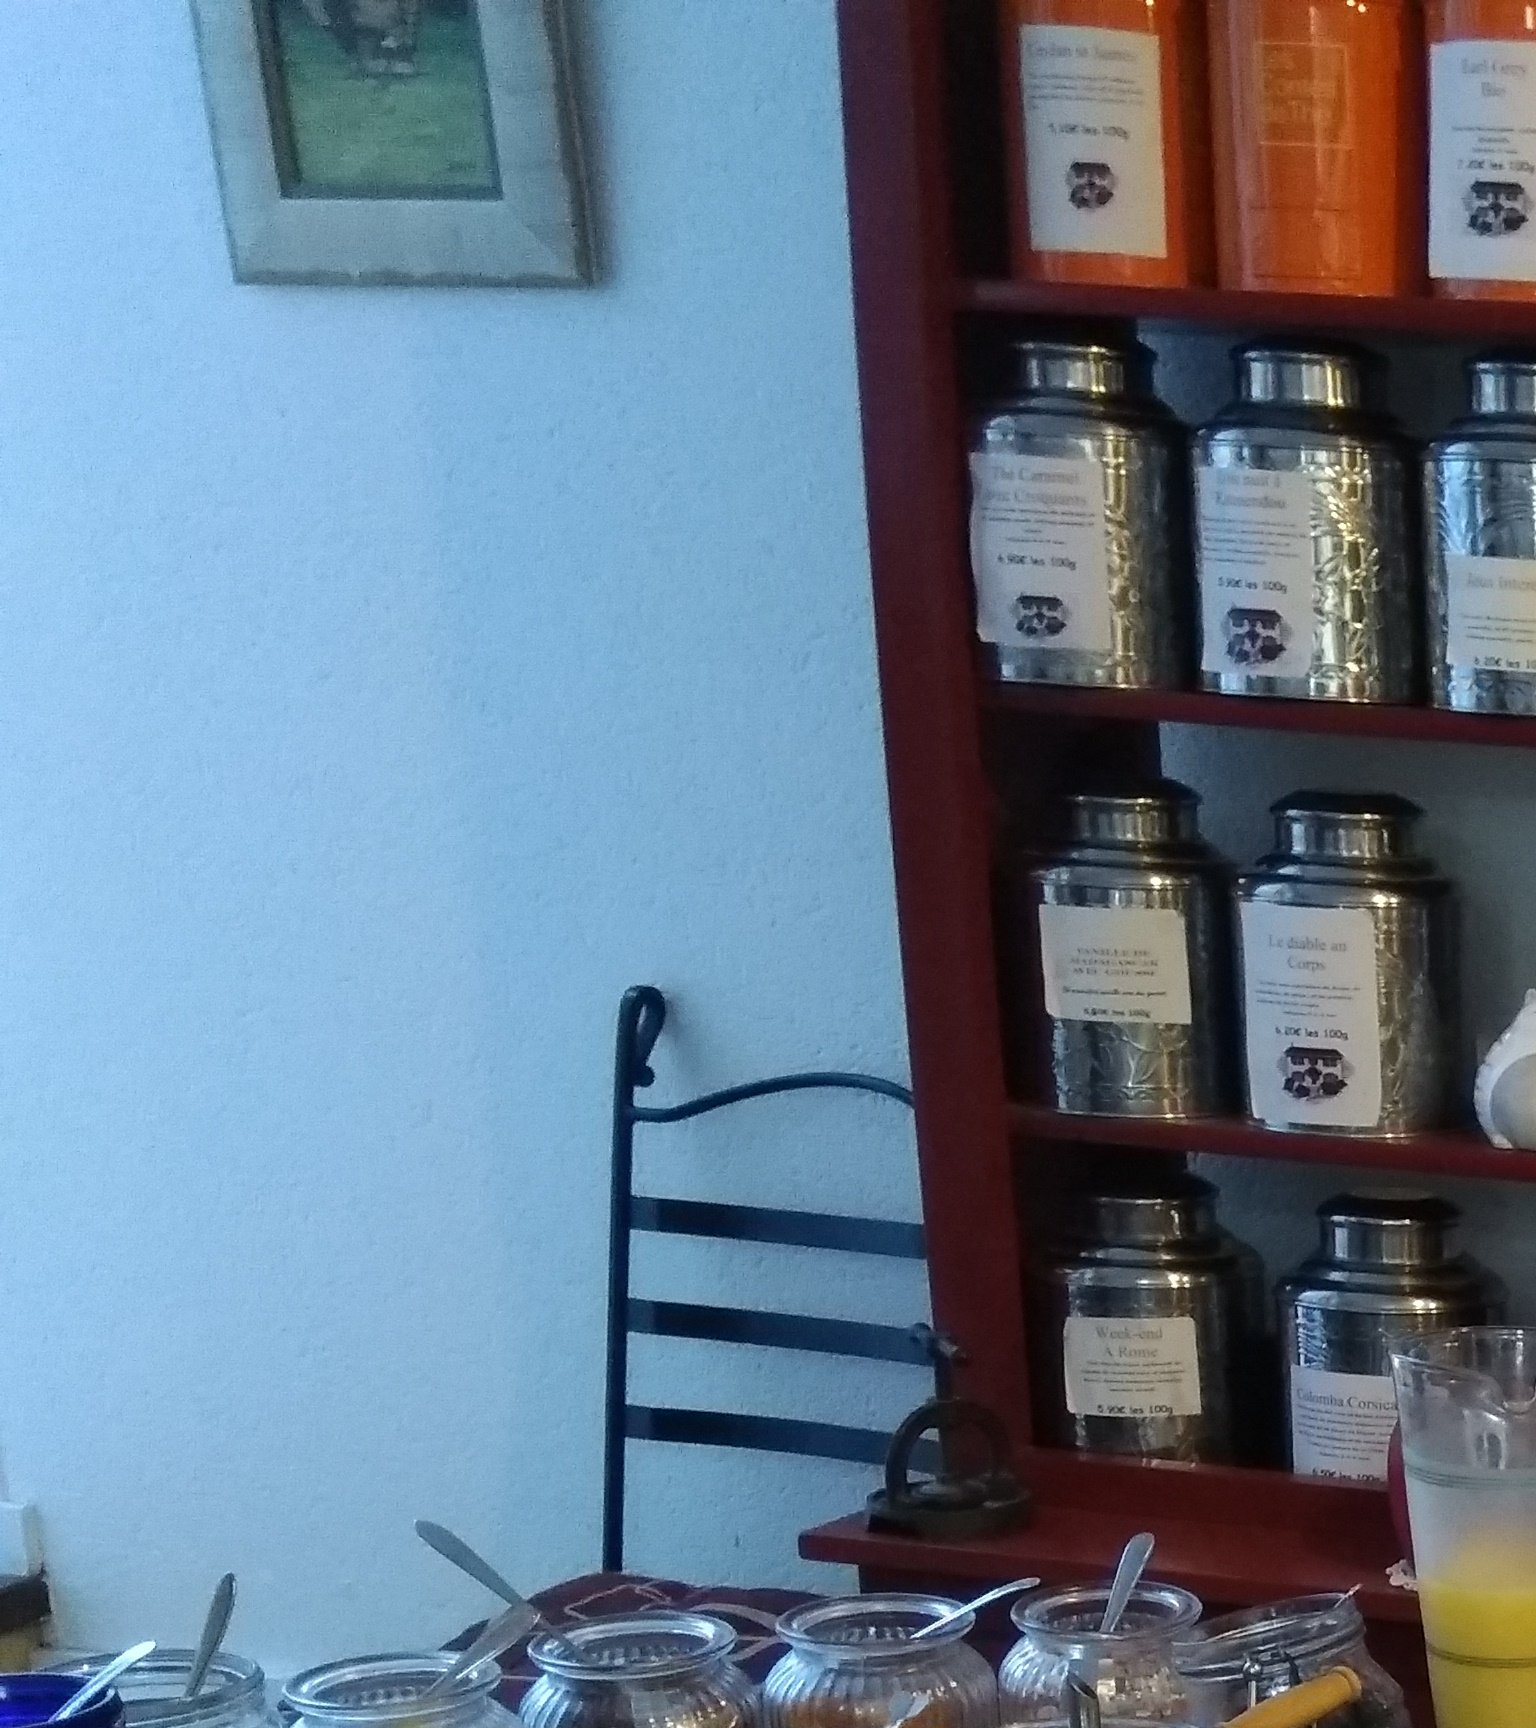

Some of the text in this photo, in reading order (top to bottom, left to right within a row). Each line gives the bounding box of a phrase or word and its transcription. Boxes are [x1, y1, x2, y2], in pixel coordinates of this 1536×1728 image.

[1286, 935, 1327, 953] diable
[1286, 955, 1328, 973] Corps
[1304, 1026, 1349, 1043] les 100g
[1128, 1404, 1174, 1417] les 100g
